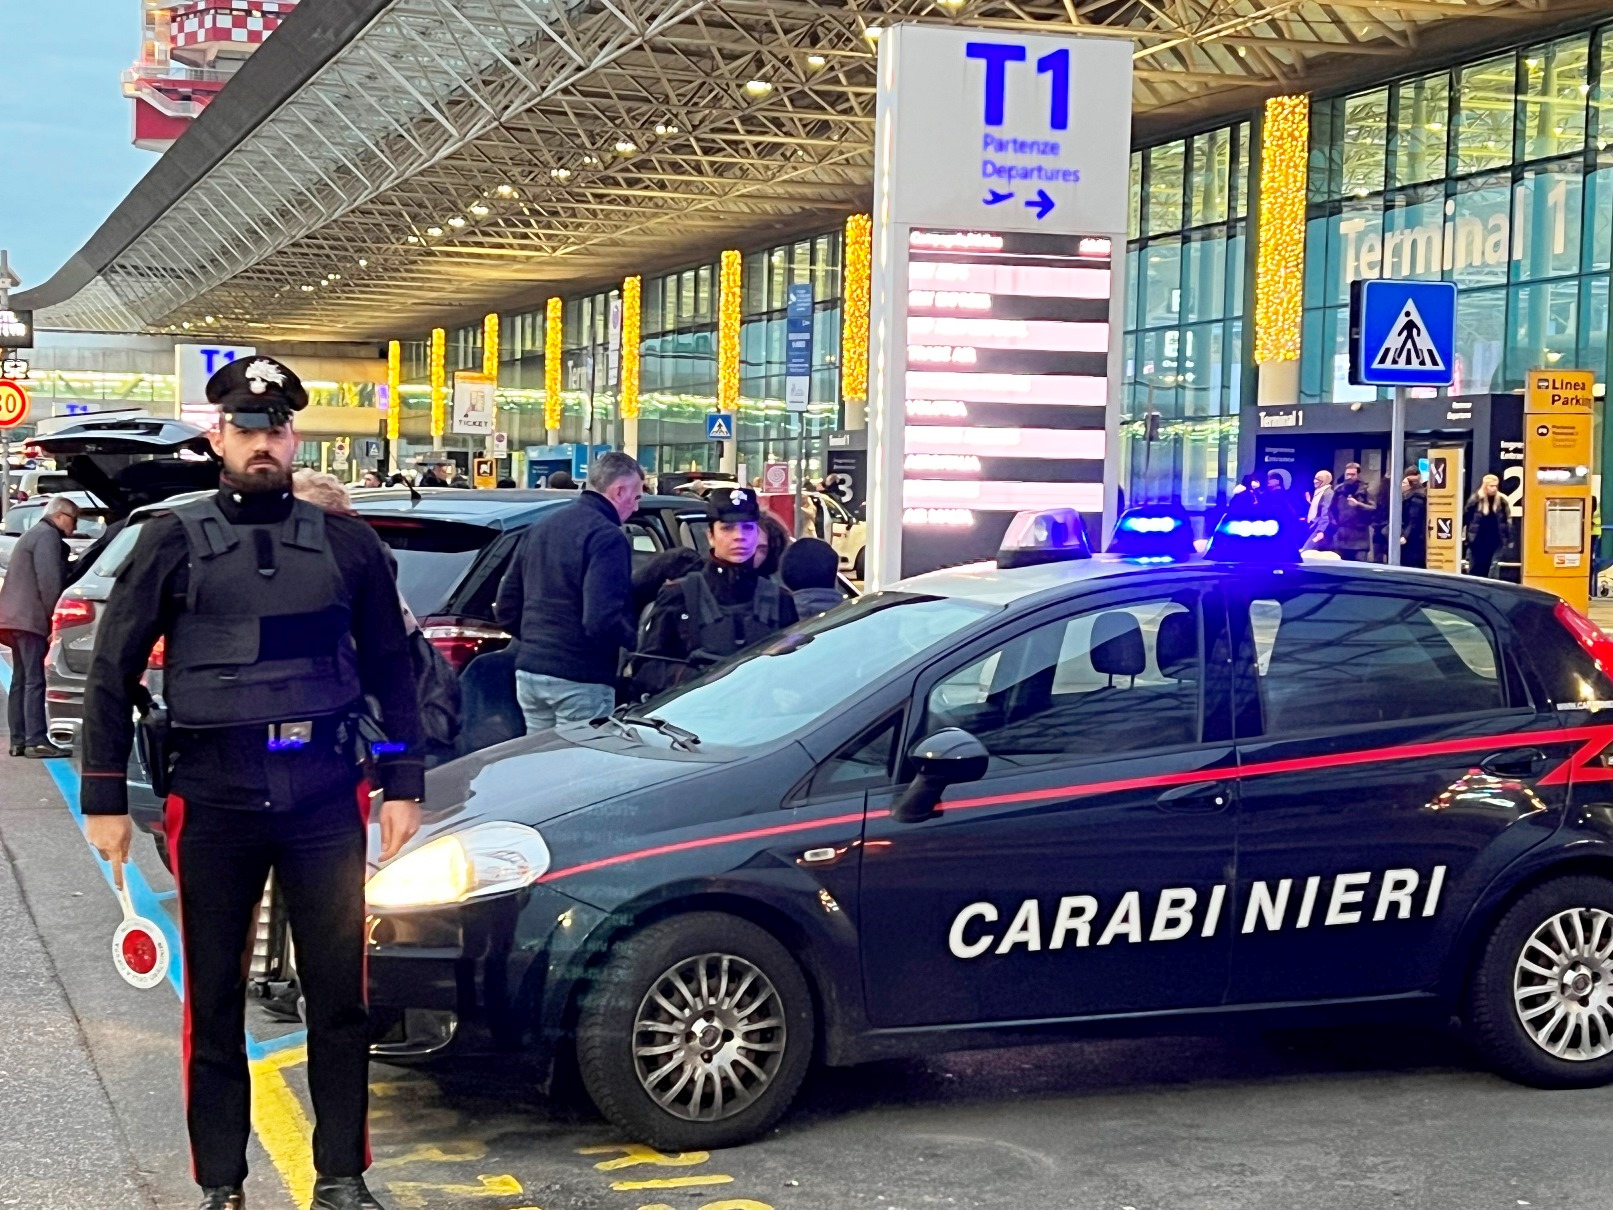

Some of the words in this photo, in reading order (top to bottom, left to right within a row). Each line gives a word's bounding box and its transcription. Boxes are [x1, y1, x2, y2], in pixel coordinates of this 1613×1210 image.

[966, 42, 1070, 131] T1
[982, 133, 1060, 157] Partenze
[981, 159, 1080, 185] Departures
[1339, 186, 1525, 284] Terminal
[1547, 180, 1568, 255] 1
[1552, 378, 1586, 391] Linea
[0, 393, 17, 414] 0
[1552, 394, 1592, 409] Park
[458, 419, 489, 428] TICKET
[837, 473, 854, 504] 3
[1504, 465, 1524, 518] 2
[947, 865, 1449, 960] CARABINIERI
